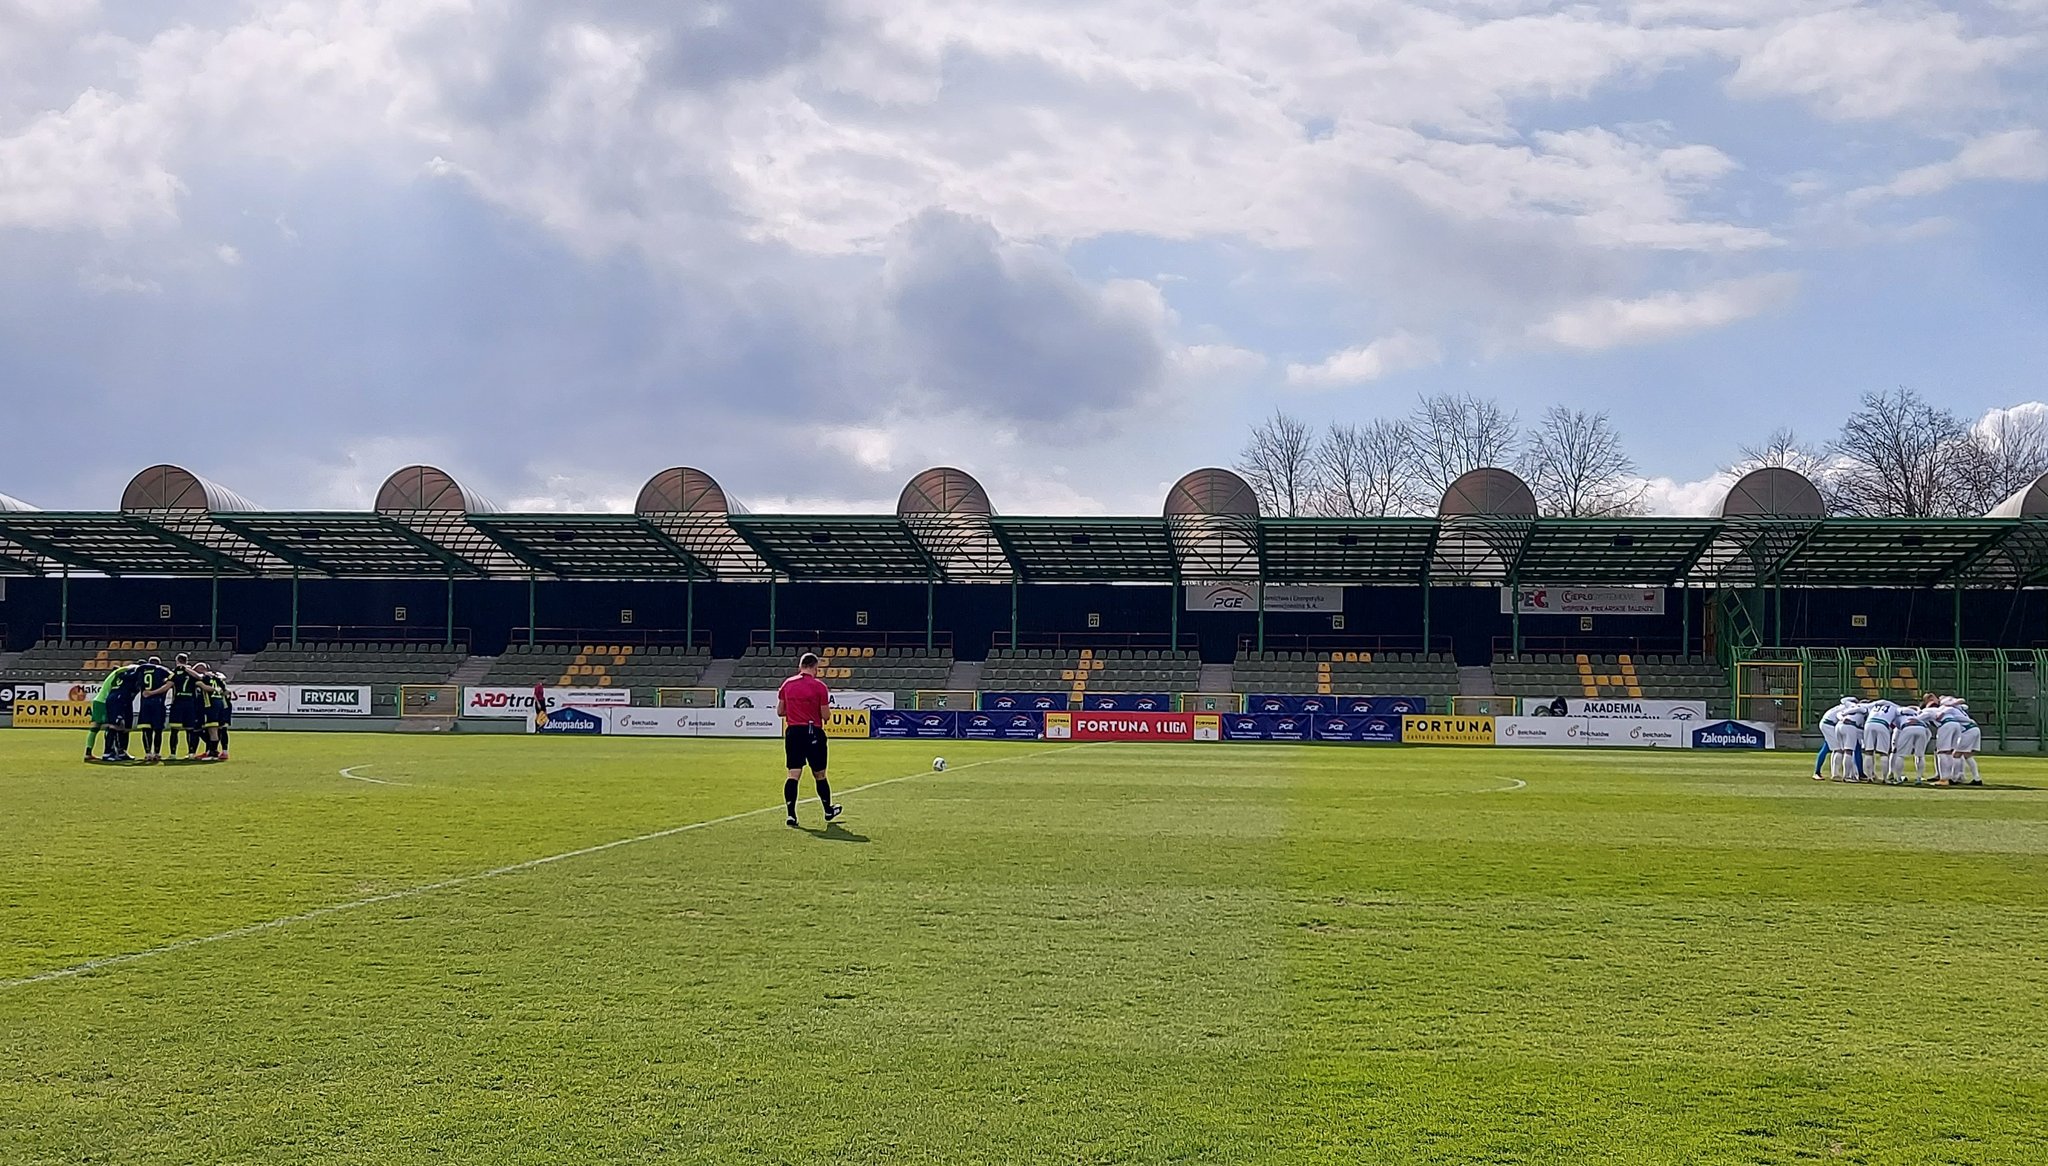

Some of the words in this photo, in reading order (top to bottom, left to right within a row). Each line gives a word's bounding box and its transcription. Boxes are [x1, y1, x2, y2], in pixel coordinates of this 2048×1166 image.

[1213, 597, 1243, 608] PGE
[144, 674, 153, 690] 9
[182, 676, 189, 692] 7
[304, 691, 355, 702] FRYSIAK
[16, 705, 93, 716] FORTUNA
[1583, 703, 1642, 713] AKADEMIA
[1672, 713, 1693, 721] PGE
[1077, 720, 1149, 732] FORTUNA
[1406, 720, 1492, 733] FORTUNA
[1701, 732, 1757, 746] Zakopiańska
